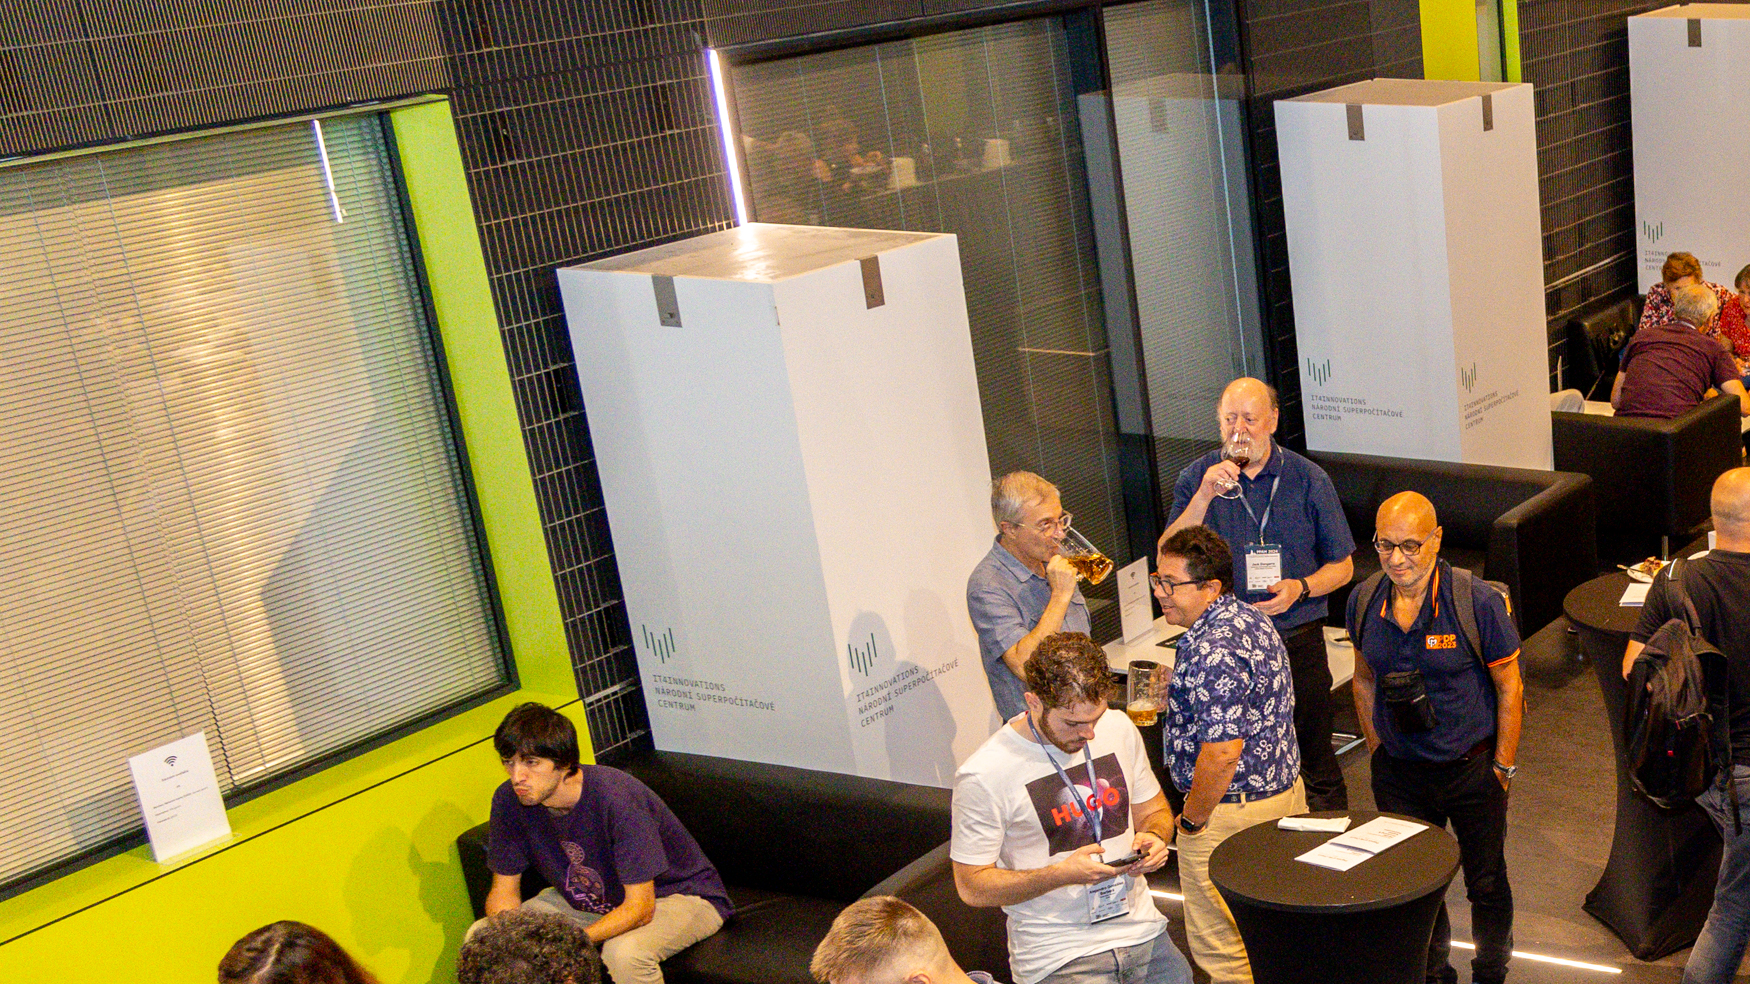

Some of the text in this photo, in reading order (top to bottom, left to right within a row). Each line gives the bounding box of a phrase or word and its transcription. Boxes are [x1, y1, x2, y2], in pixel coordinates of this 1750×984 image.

[1311, 394, 1367, 406] IT4INNOVATIONS
[1312, 413, 1342, 421] CENTRUM
[652, 674, 726, 692] IT4INNOVATIONS
[856, 665, 919, 703] IT4INNOVATIONS
[858, 658, 959, 715] NÁRODNÍ SUPERPOČÍTAČOVÉ
[655, 686, 776, 711] NÁRODNÍ SUPERPOČÍTAČOVÉ
[657, 699, 696, 712] CENTRUM
[860, 704, 895, 728] CENTRUM
[1051, 787, 1120, 827] HUGO
